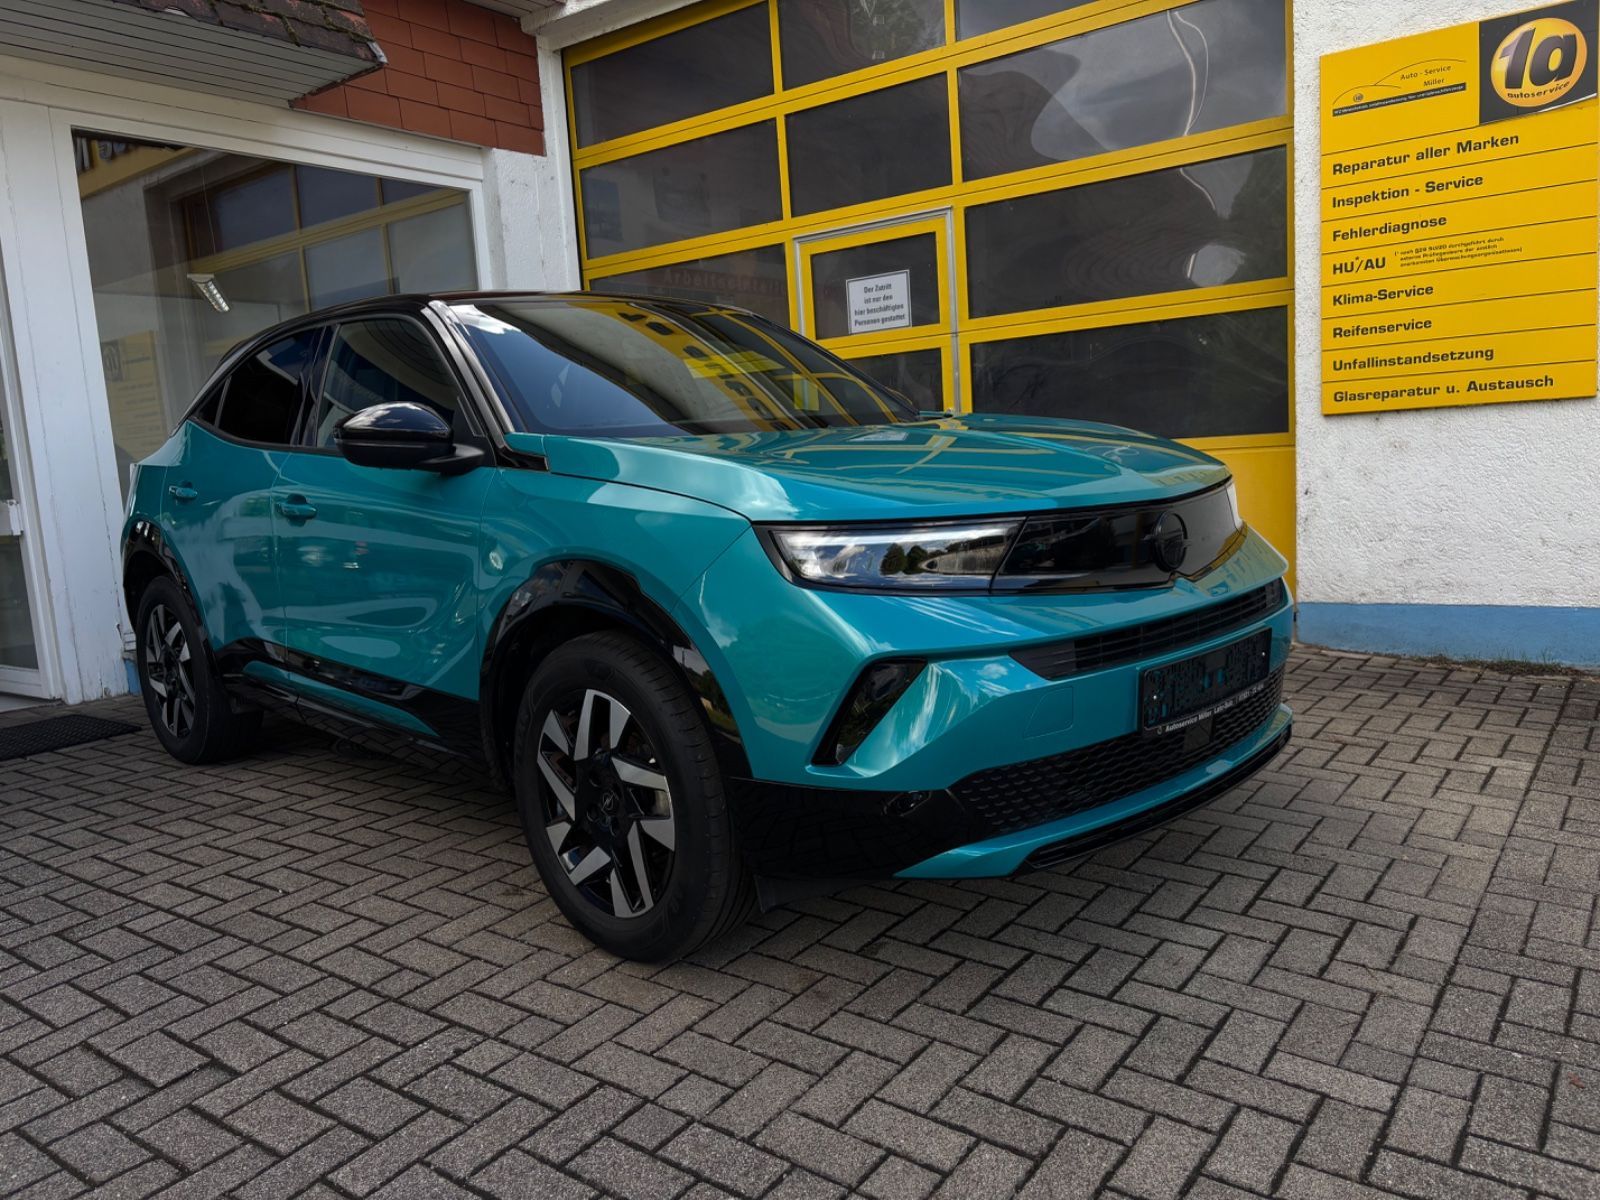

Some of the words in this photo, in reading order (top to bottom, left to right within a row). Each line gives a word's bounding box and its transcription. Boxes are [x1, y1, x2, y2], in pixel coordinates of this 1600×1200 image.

[1499, 27, 1577, 89] 1a
[1400, 71, 1418, 80] Auto
[1424, 65, 1451, 76] Service
[1423, 77, 1445, 87] Miller
[1507, 81, 1570, 98] autoservice
[1332, 153, 1410, 176] Reparatur
[1415, 146, 1450, 161] aller
[1456, 134, 1519, 154] Marken
[1332, 188, 1410, 208] Inspektion
[1425, 175, 1483, 194] Service
[1332, 216, 1447, 242] Fehlerdiagnose
[864, 286, 873, 294] Der
[875, 283, 892, 292] Zutritt
[1332, 285, 1434, 306] Klima-Service
[854, 317, 880, 326] Personen
[1332, 319, 1432, 339] Reifenservice
[1332, 348, 1494, 371] Unfallinstandsetzung
[1333, 385, 1440, 402] Glasreparatur
[1446, 384, 1460, 394] u.
[1467, 375, 1554, 393] Austausch
[1165, 717, 1198, 732] Autoservice
